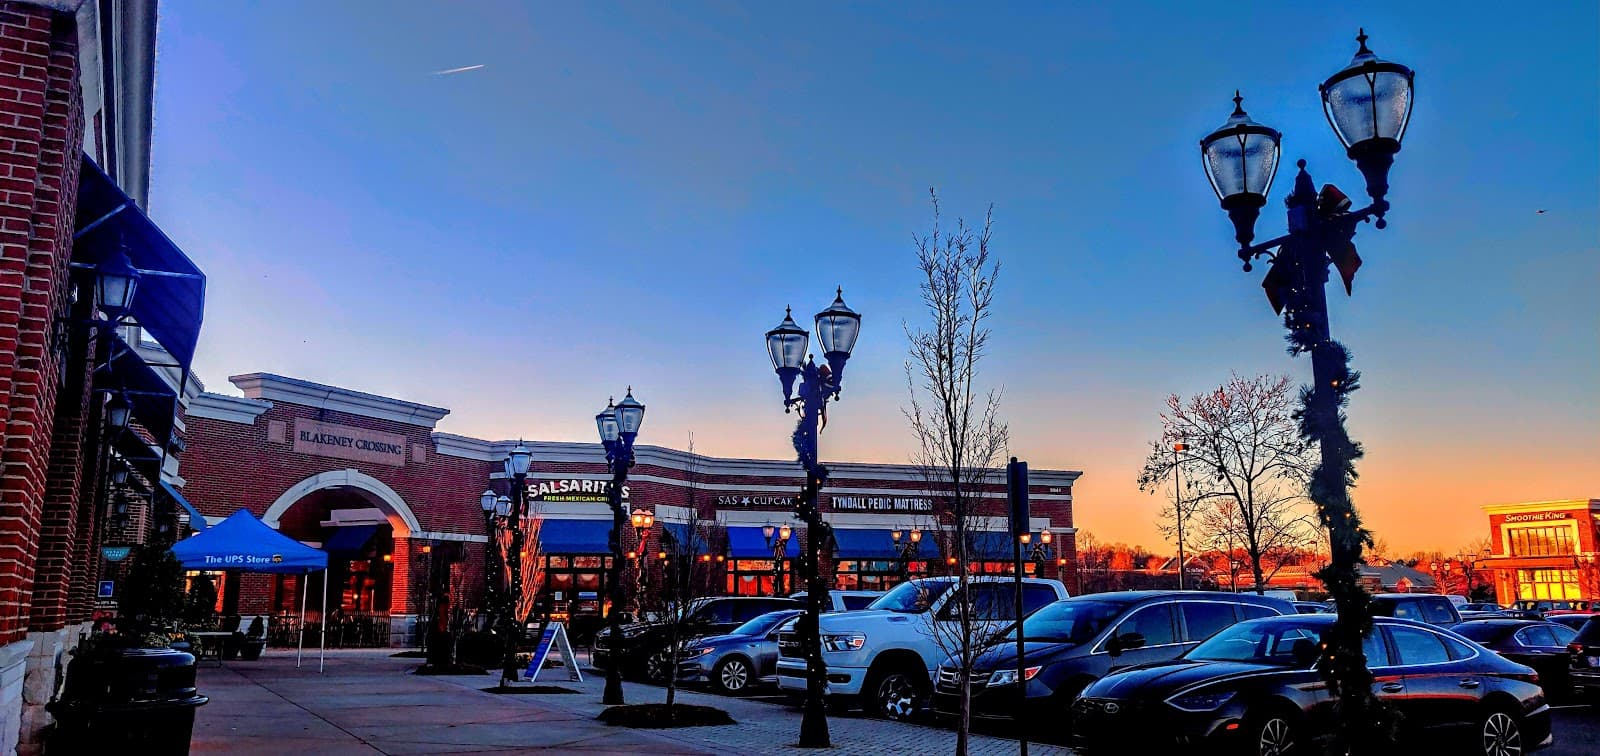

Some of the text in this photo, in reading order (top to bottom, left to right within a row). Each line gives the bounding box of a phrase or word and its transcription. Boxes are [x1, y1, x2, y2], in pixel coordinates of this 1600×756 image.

[300, 430, 402, 455] BLAKENEY CROSSING
[718, 495, 738, 505] SAS
[832, 496, 933, 511] TYNDALL PEDIC MATTRESS
[1505, 511, 1566, 522] SMOOTHIE KING
[204, 555, 223, 564] The
[225, 554, 244, 564] UPS
[246, 555, 271, 564] Store
